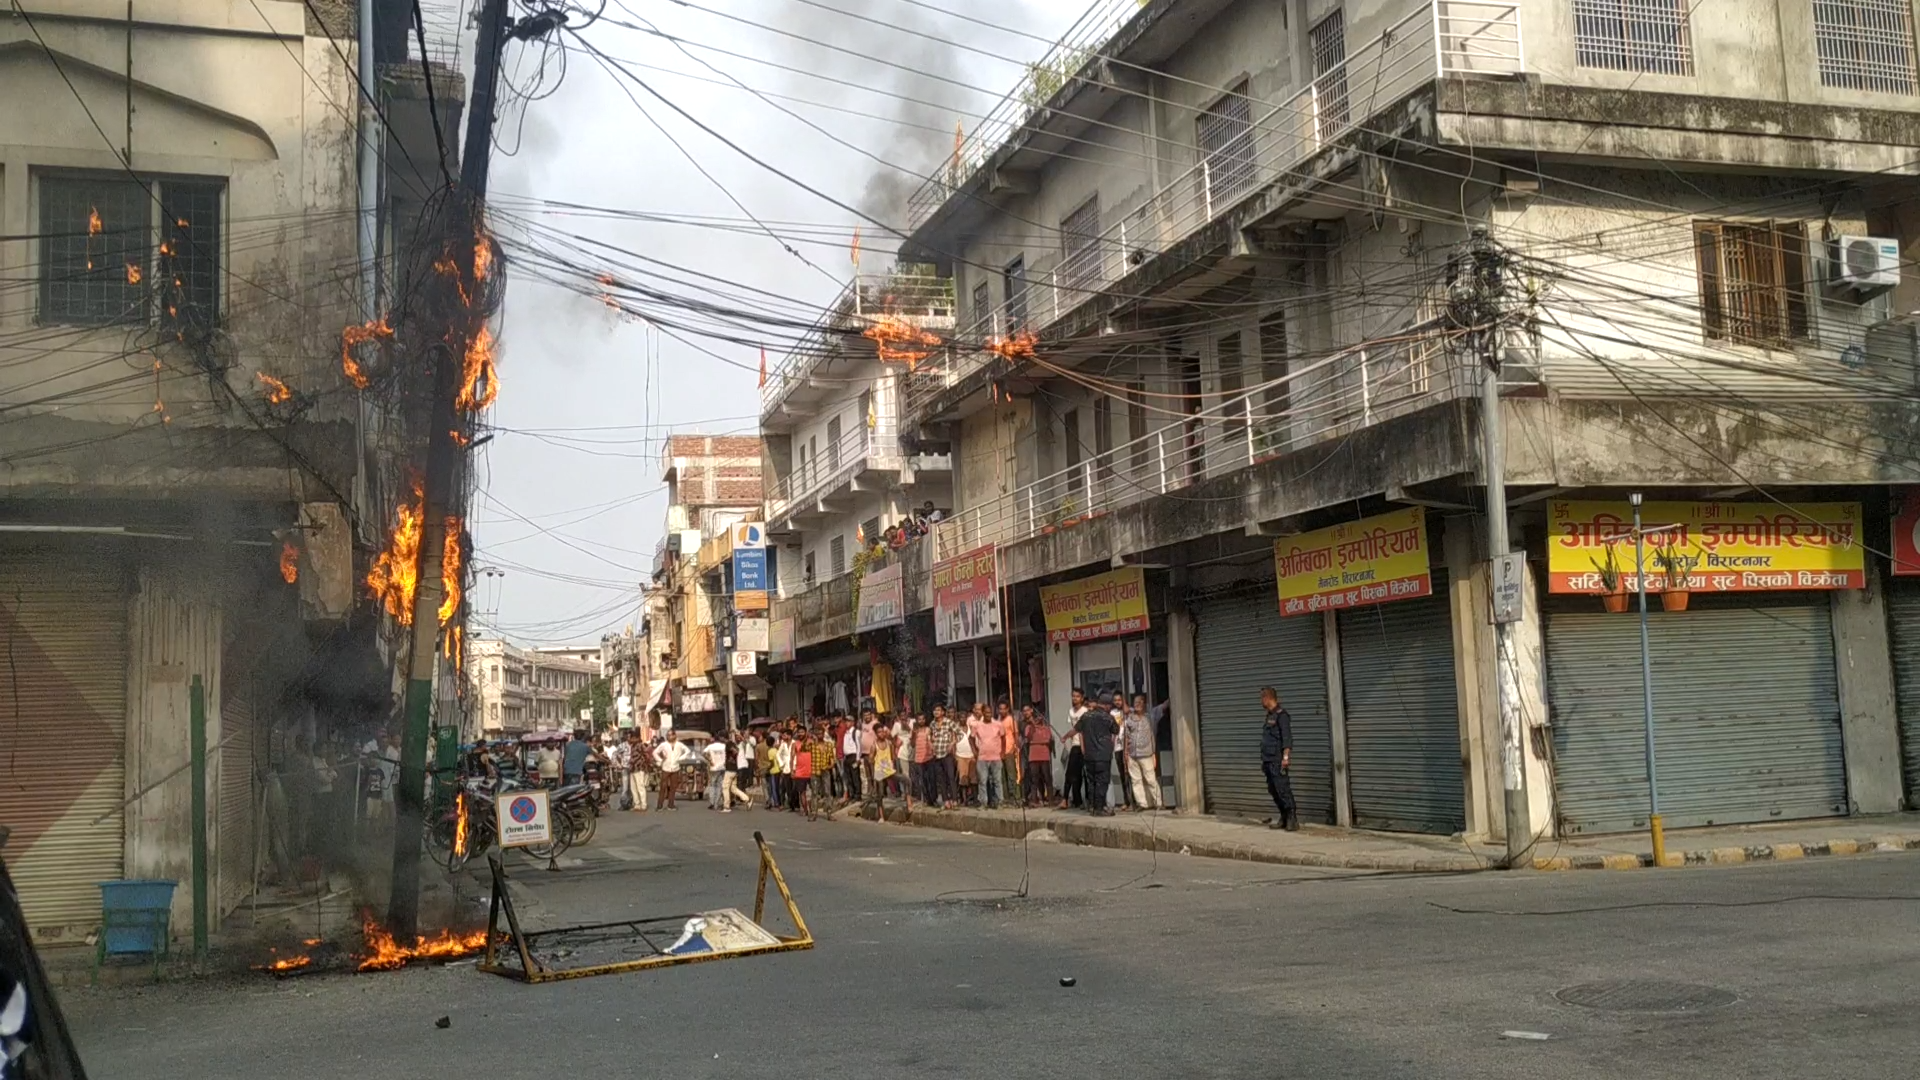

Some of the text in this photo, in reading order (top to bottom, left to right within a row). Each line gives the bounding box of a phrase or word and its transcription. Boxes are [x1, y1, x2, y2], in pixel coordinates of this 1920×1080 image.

[1701, 514, 1853, 551] इम्पोरियम
[1277, 527, 1420, 578] अम्बिका इम्पोरियम
[1707, 552, 1772, 567] विराटनगर
[1712, 575, 1737, 590] सुट
[1743, 571, 1792, 587] पिसको
[1798, 571, 1848, 586] विक्रेता
[1044, 581, 1139, 616] अम्बिका इम्पोरियम
